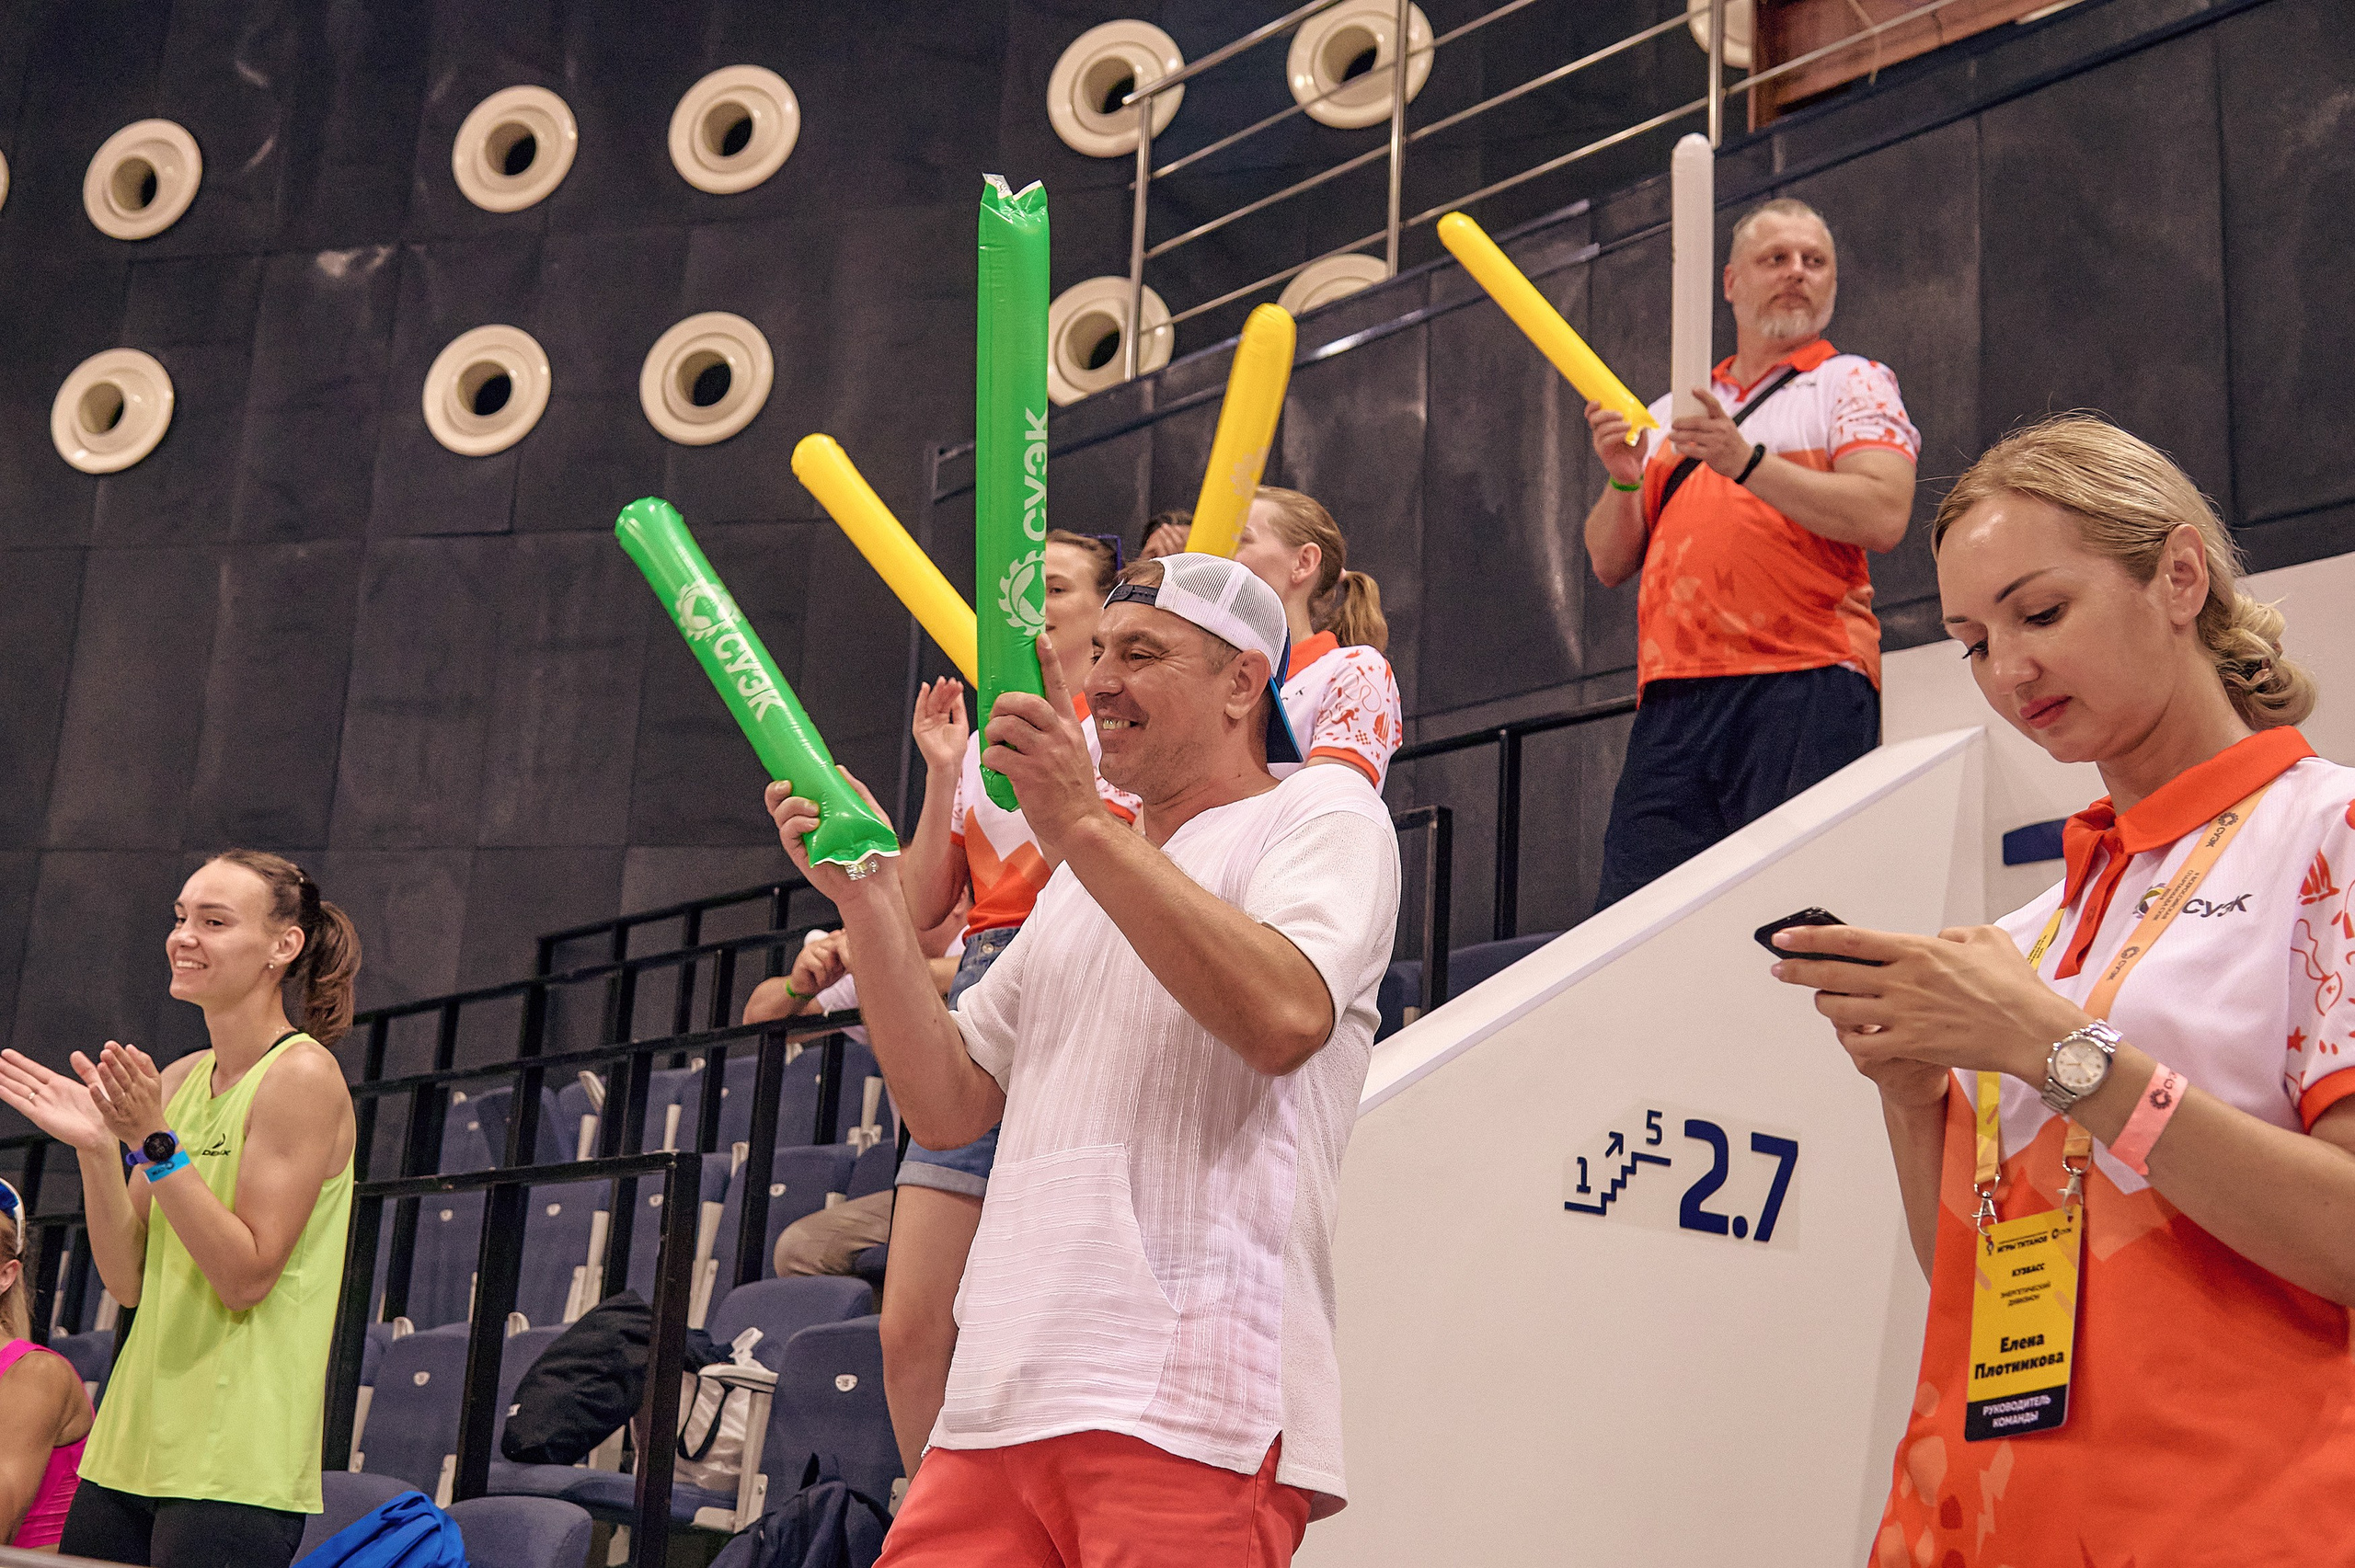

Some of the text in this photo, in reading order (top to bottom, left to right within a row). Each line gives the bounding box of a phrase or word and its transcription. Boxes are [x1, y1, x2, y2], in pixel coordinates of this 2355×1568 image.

[1023, 406, 1048, 542] СУЭК
[714, 631, 787, 722] СУЭК
[2181, 893, 2254, 918] СУЭК
[1646, 1109, 1663, 1146] 5
[1576, 1156, 1591, 1195] 1
[1679, 1118, 1799, 1243] 2.7
[2011, 1263, 2046, 1277] КУЗБАСС
[2000, 1333, 2044, 1355] Елена
[1974, 1351, 2065, 1379] Плотникова
[1982, 1394, 2051, 1416] РУКОВОДИТЕЛЬ
[1992, 1410, 2039, 1428] КОМАНДЫ
